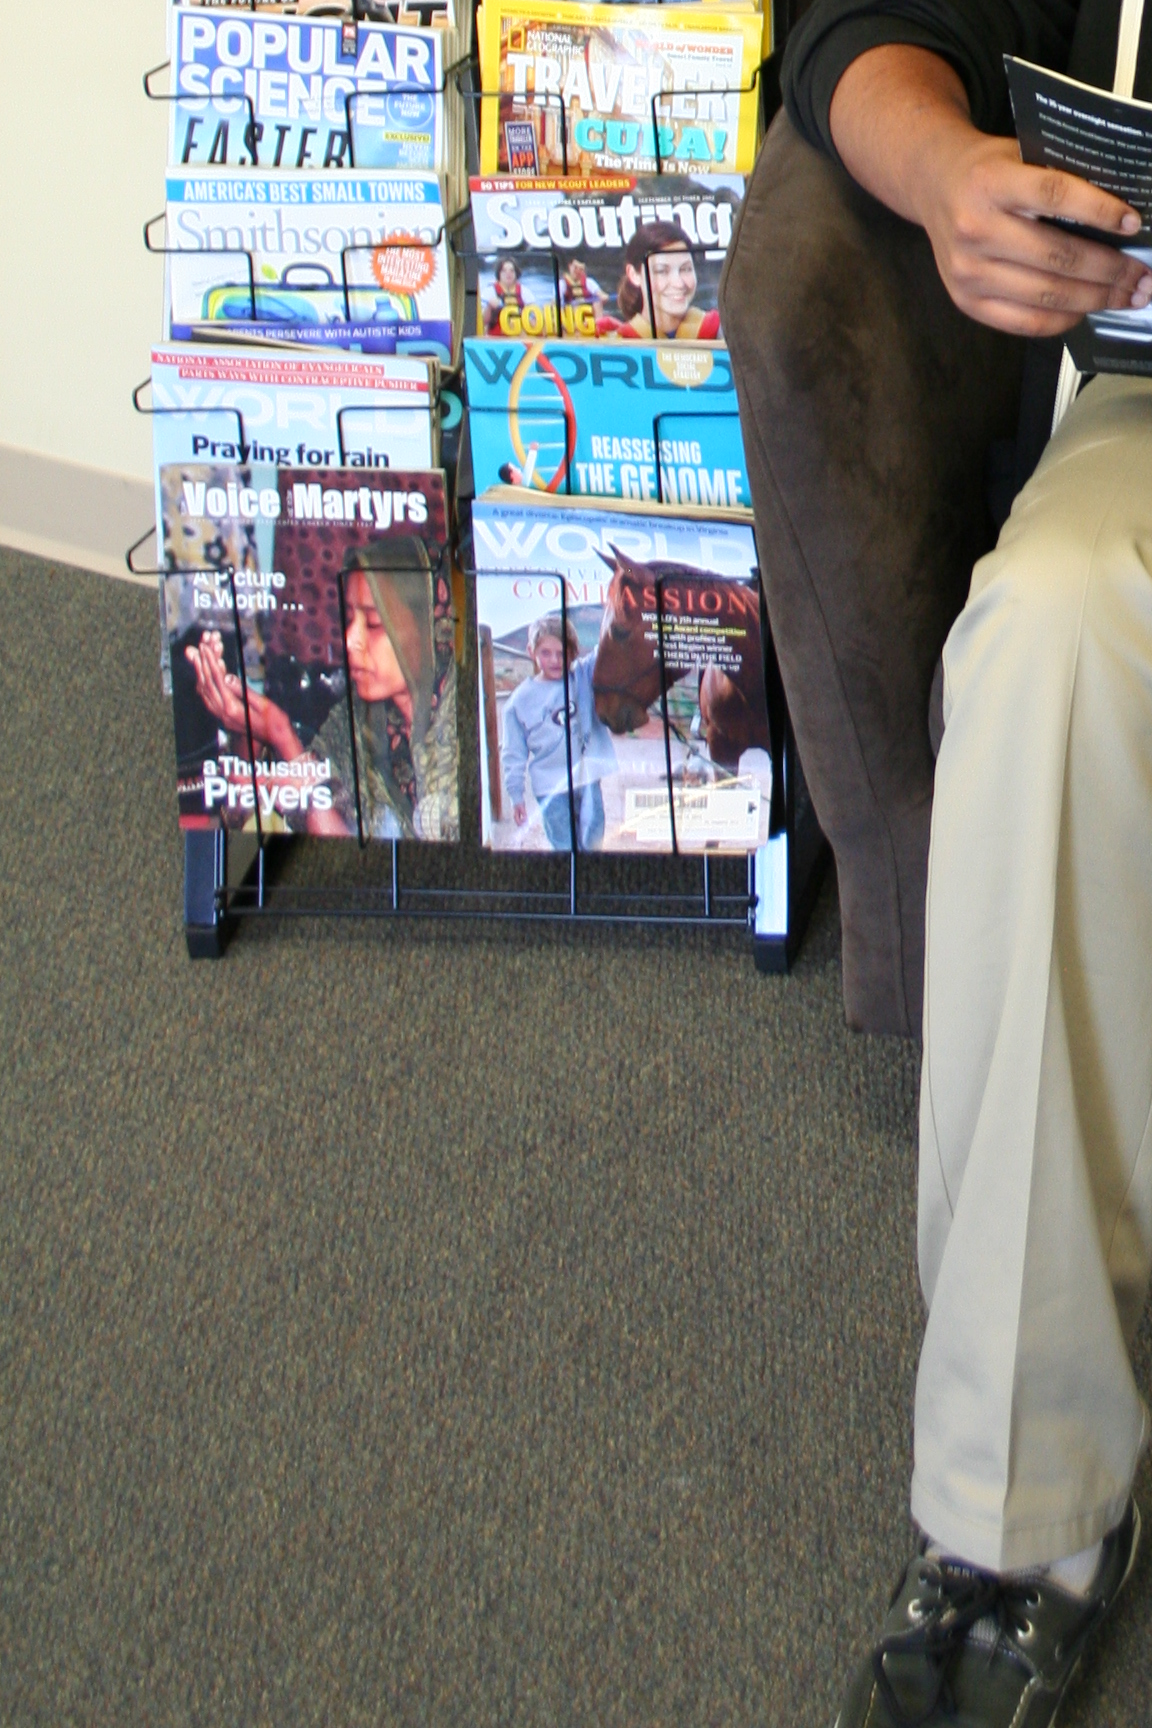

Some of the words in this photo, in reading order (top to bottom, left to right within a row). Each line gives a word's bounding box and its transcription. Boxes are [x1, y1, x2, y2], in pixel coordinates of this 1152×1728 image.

[526, 41, 584, 55] GEOGRAPHIC
[527, 31, 571, 43] NATIONAL
[181, 15, 431, 84] POPULAR
[687, 44, 734, 56] WONDER
[177, 63, 387, 127] SCIENCE
[507, 53, 730, 122] TRAVELER
[181, 116, 349, 169] FASTER
[575, 117, 726, 162] CUBA!
[512, 152, 534, 167] APP
[595, 154, 621, 168] The
[663, 159, 676, 171] Is
[678, 161, 710, 174] Now
[184, 180, 266, 202] AMERICA'S
[269, 180, 308, 202] BEST
[312, 181, 365, 202] SMALL
[368, 181, 426, 202] TOWNS
[480, 181, 493, 191] 50
[495, 180, 514, 191] TIPS
[515, 181, 533, 190] FOR
[535, 180, 556, 190] NEW
[558, 180, 587, 189] SCOUT
[589, 178, 630, 189] LEADERS
[500, 304, 595, 336] GOING
[265, 329, 322, 339] PERSEVERE
[324, 328, 351, 338] WITH
[352, 326, 396, 338] AUTISTIC
[398, 325, 422, 336] KIDS
[157, 353, 208, 365] NATIONAL
[214, 358, 282, 371] ASSOCIATION
[284, 362, 297, 371] OF
[301, 363, 382, 375] EVANGELICALS
[181, 368, 215, 379] PARTS
[217, 370, 246, 380] WAYS
[248, 373, 279, 383] WITH
[281, 375, 371, 388] CONTRACEPTIVE
[374, 379, 418, 391] PUSHER
[153, 382, 429, 432] WORLD
[192, 435, 292, 466] Praying
[297, 443, 335, 465] for
[344, 446, 389, 467] rain
[591, 435, 701, 464] REASSESSING
[576, 463, 615, 494] THE
[620, 463, 743, 507] GENOME
[182, 480, 281, 517] Voice
[293, 483, 428, 530] Martyrs
[500, 509, 523, 518] great
[193, 571, 209, 587] A
[215, 567, 286, 588] Pcture
[194, 590, 211, 609] Is
[214, 590, 277, 611] Worth
[203, 759, 217, 776] a
[218, 756, 331, 778] Thousand
[203, 777, 332, 816] Prayers
